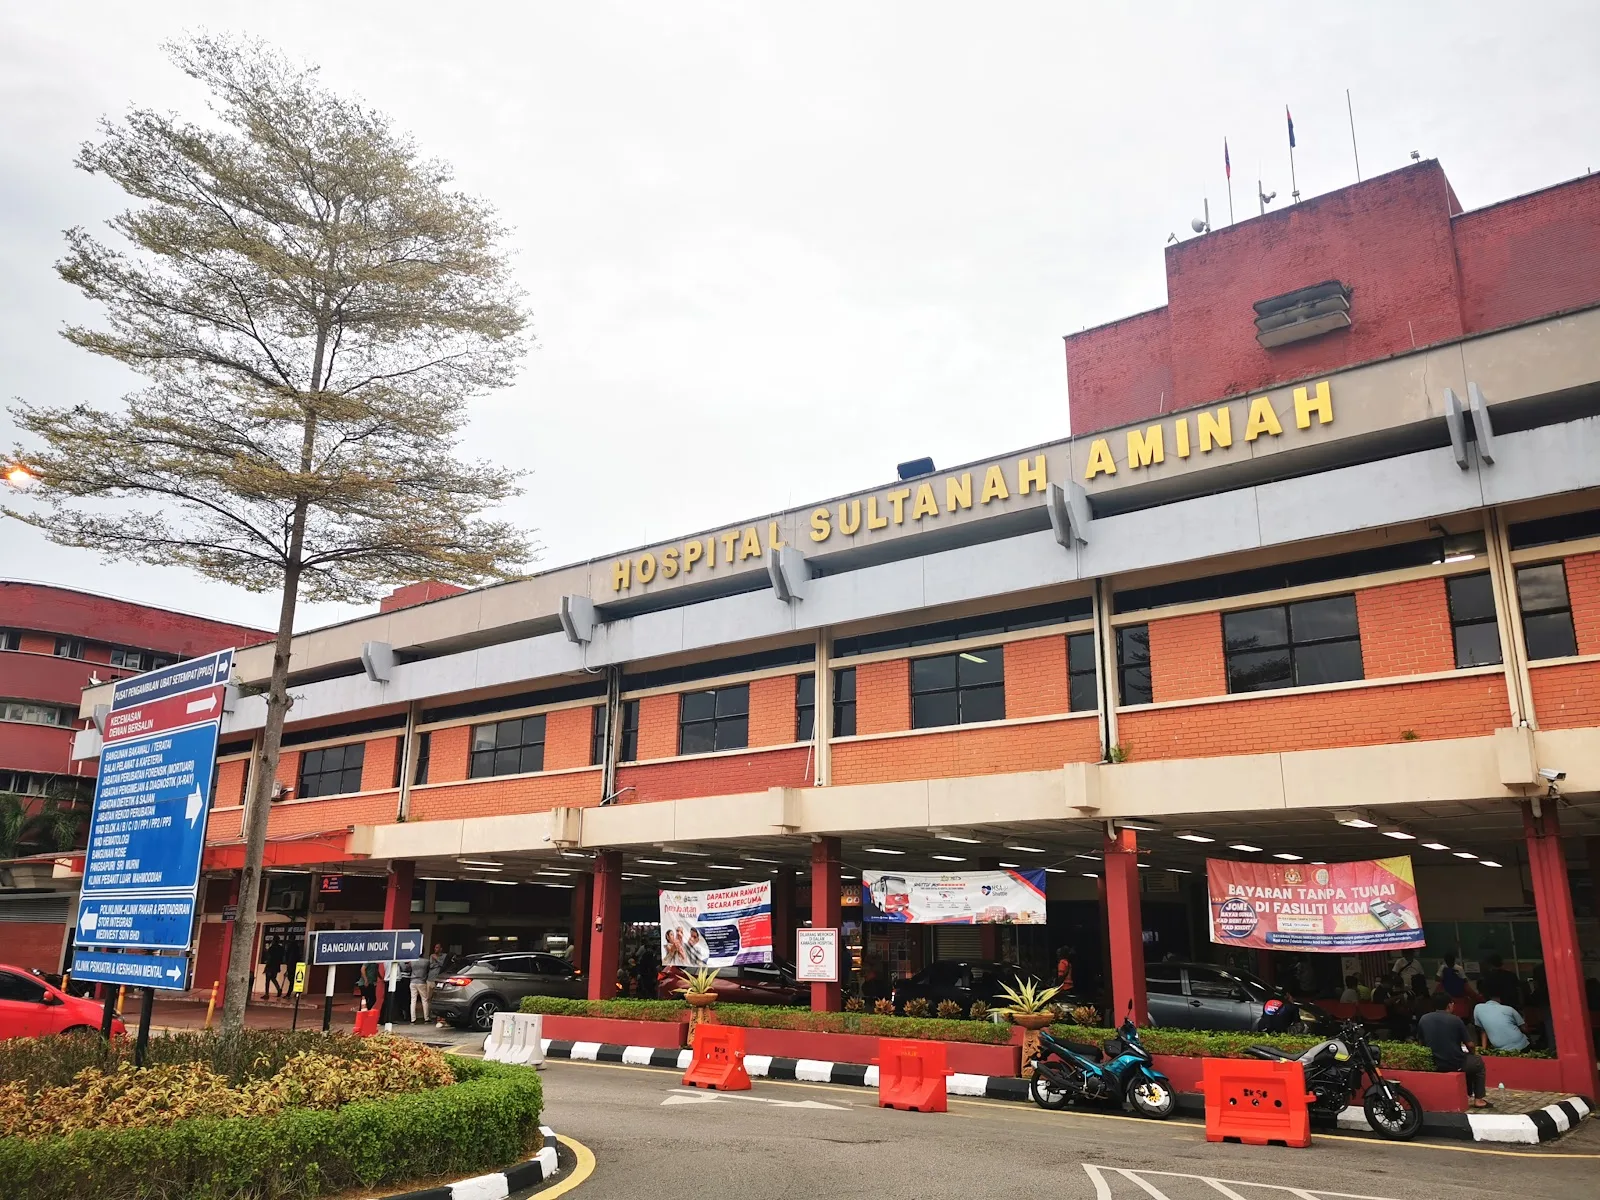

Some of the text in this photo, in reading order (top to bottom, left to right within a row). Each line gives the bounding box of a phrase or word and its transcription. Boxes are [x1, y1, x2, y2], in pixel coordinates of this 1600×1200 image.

[612, 381, 1334, 591] HOSPITAL SULTANAH AMINAH
[115, 664, 214, 701] PUSAT PENGAMBILAN UBAT SETEMPAT (PPUS)
[110, 711, 142, 726] KECEMASAN
[109, 719, 154, 738] DEWAN BERSALIN
[105, 750, 128, 761] BANGUNAN
[128, 744, 150, 757] BAKAWALI
[153, 739, 172, 752] TERATAI
[104, 764, 116, 773] BALAI
[116, 759, 135, 771] PELAWAT
[139, 754, 163, 766] KAFETERIA
[102, 774, 120, 786] JABATAN
[120, 769, 146, 783] PERUBATAN
[145, 765, 167, 778] FORENSIK
[100, 787, 119, 798] JABATAN
[119, 781, 145, 795] PENGIMEJAN
[150, 776, 176, 790] DIAGNOSTIK
[176, 773, 194, 788] (X-RAY)
[98, 799, 117, 810] JABATAN
[116, 796, 136, 808] DIETETIK
[139, 793, 155, 805] SAJIAN
[96, 805, 156, 822] JABATAN REKOD PERUBATAN
[95, 825, 104, 834] WAD
[104, 823, 116, 834] BLOK
[94, 834, 130, 847] WAD HEMATOLOGI
[92, 847, 127, 860] BANGUNAN ROSE
[90, 859, 140, 872] PANGSAPURI SRI MURNI
[88, 872, 162, 885] KLINIK PESAKIT LUAR MAHMOODIAH
[706, 891, 738, 900] DAPATKAN
[740, 884, 768, 897] RAWATAN
[1228, 884, 1396, 900] BAYARAN TANPA TUNAI
[138, 904, 153, 914] PAKAR
[157, 904, 190, 914] PENTADBIRAN
[707, 901, 731, 909] SECARA
[1255, 901, 1369, 915] DI FASILITI KKM
[97, 917, 133, 927] STOR INTEGRASI
[96, 929, 140, 940] MEDIVEST SDN BHD
[321, 942, 389, 953] BANGUNAN INDUK
[75, 960, 162, 978] KLINIK PSIKIATRI & KESIHATAN MENTAL
